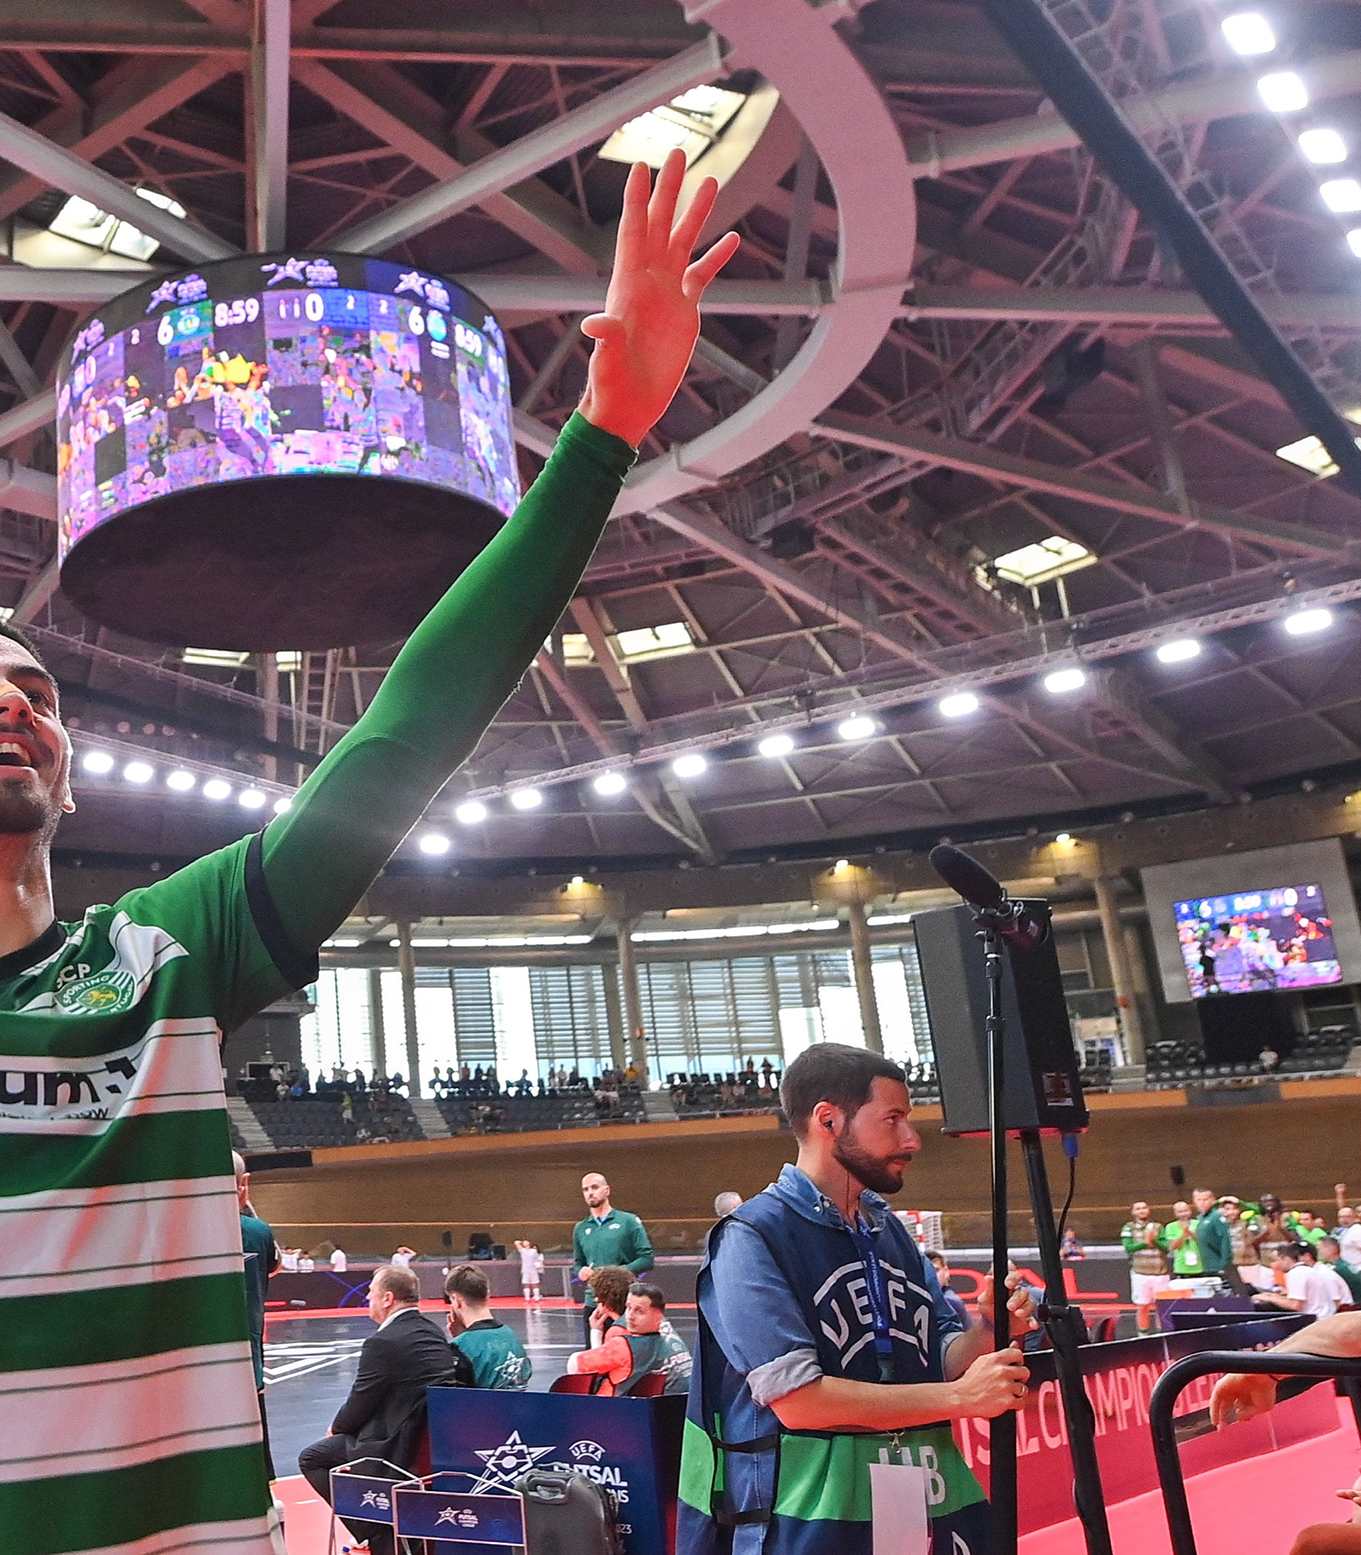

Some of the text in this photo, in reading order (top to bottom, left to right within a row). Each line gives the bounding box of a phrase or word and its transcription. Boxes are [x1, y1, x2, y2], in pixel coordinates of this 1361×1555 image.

[214, 298, 260, 327] 8:59
[408, 306, 425, 336] 6
[157, 315, 174, 346] 6
[63, 974, 110, 1004] SPORTING
[820, 1278, 929, 1354] UEFA
[571, 1443, 602, 1461] UEFA
[553, 1463, 628, 1487] TSAL
